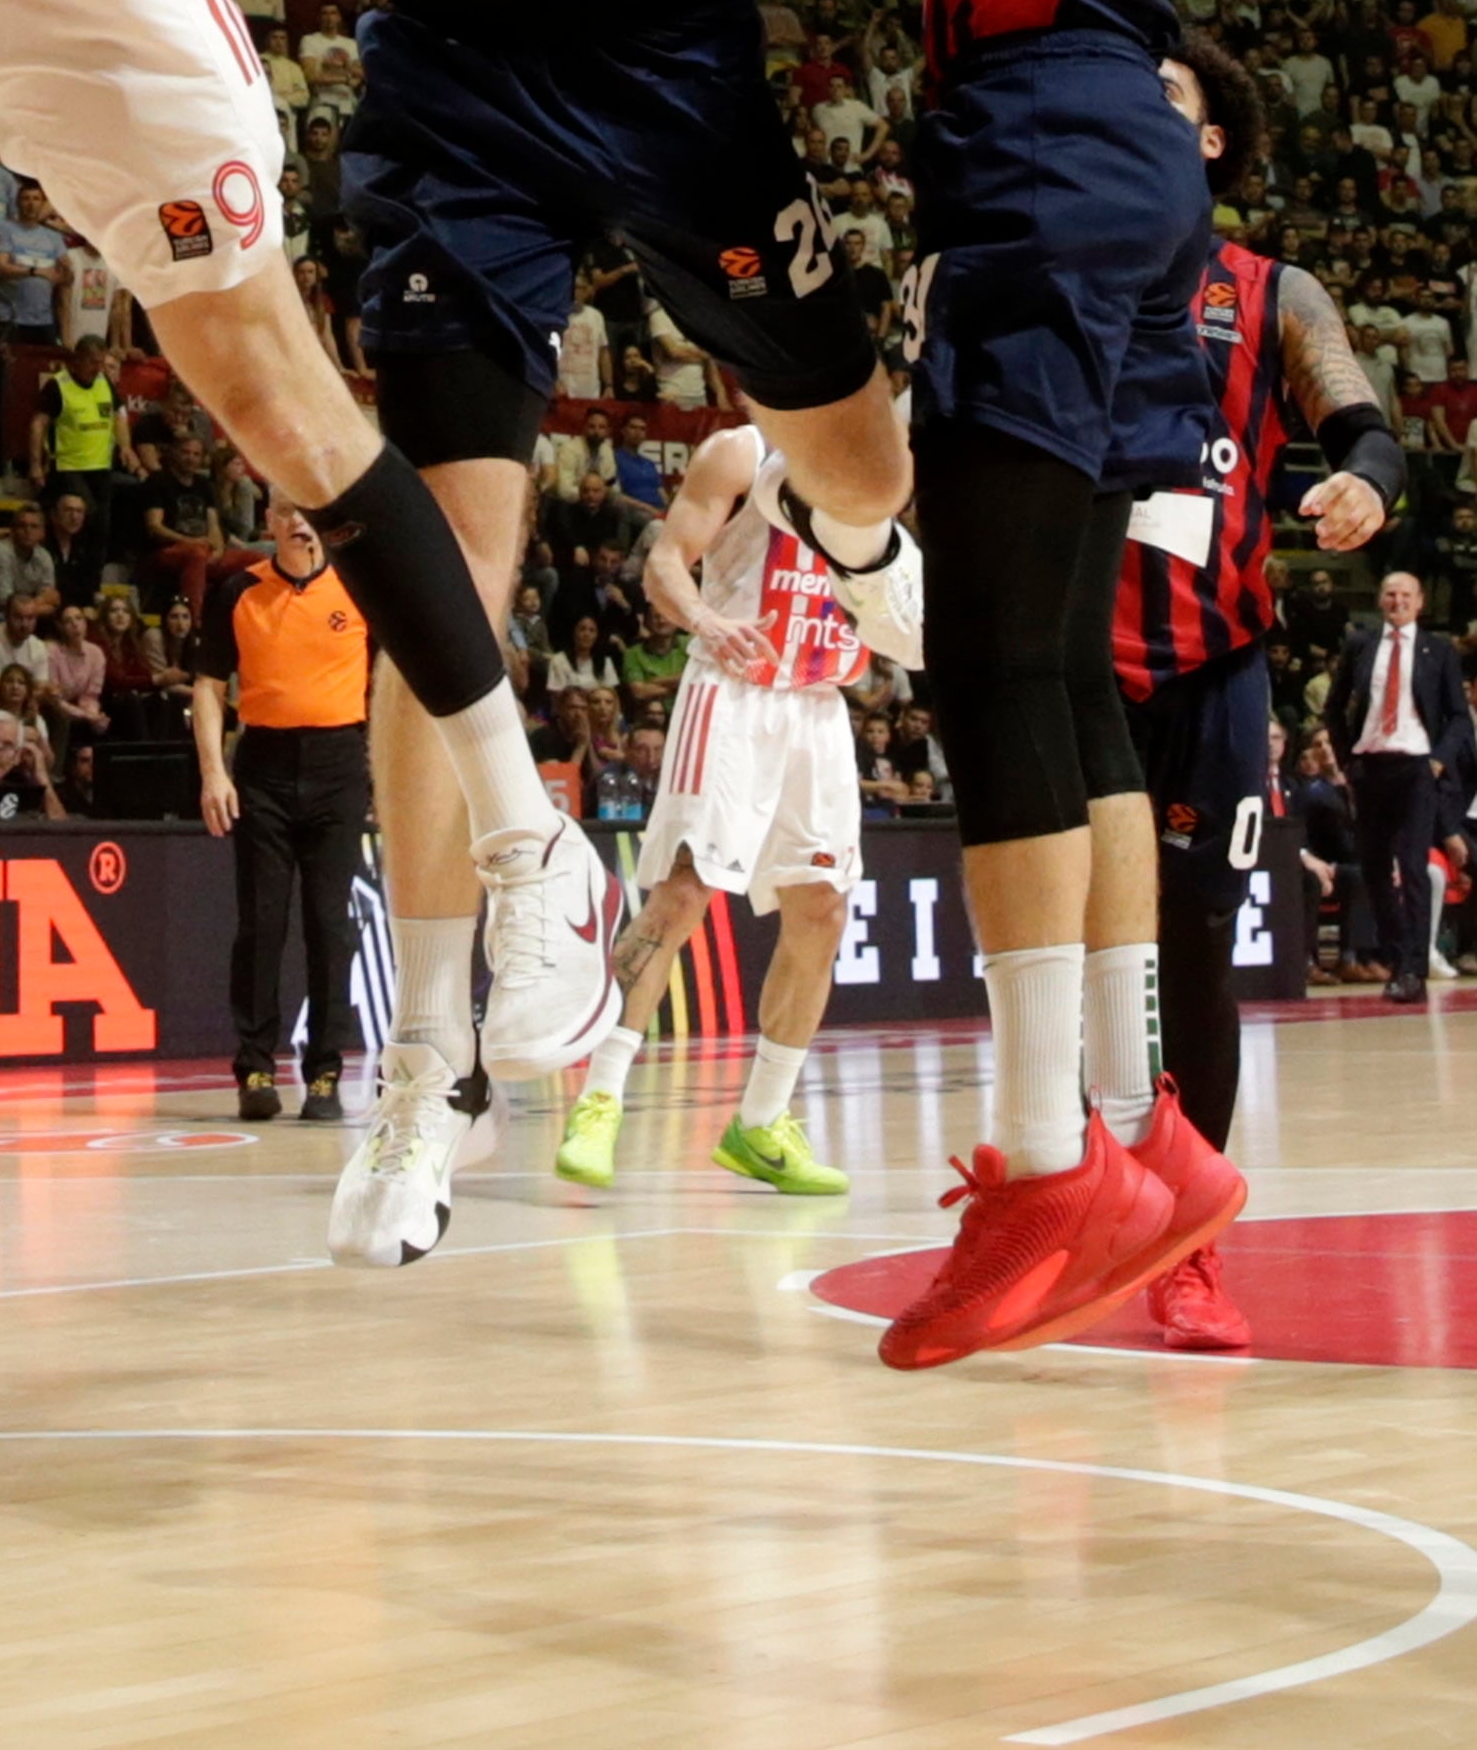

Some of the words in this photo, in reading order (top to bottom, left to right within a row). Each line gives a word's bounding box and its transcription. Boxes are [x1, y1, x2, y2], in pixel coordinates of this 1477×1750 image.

[212, 160, 264, 250] 9
[786, 613, 861, 651] mts
[1228, 796, 1263, 870] 0
